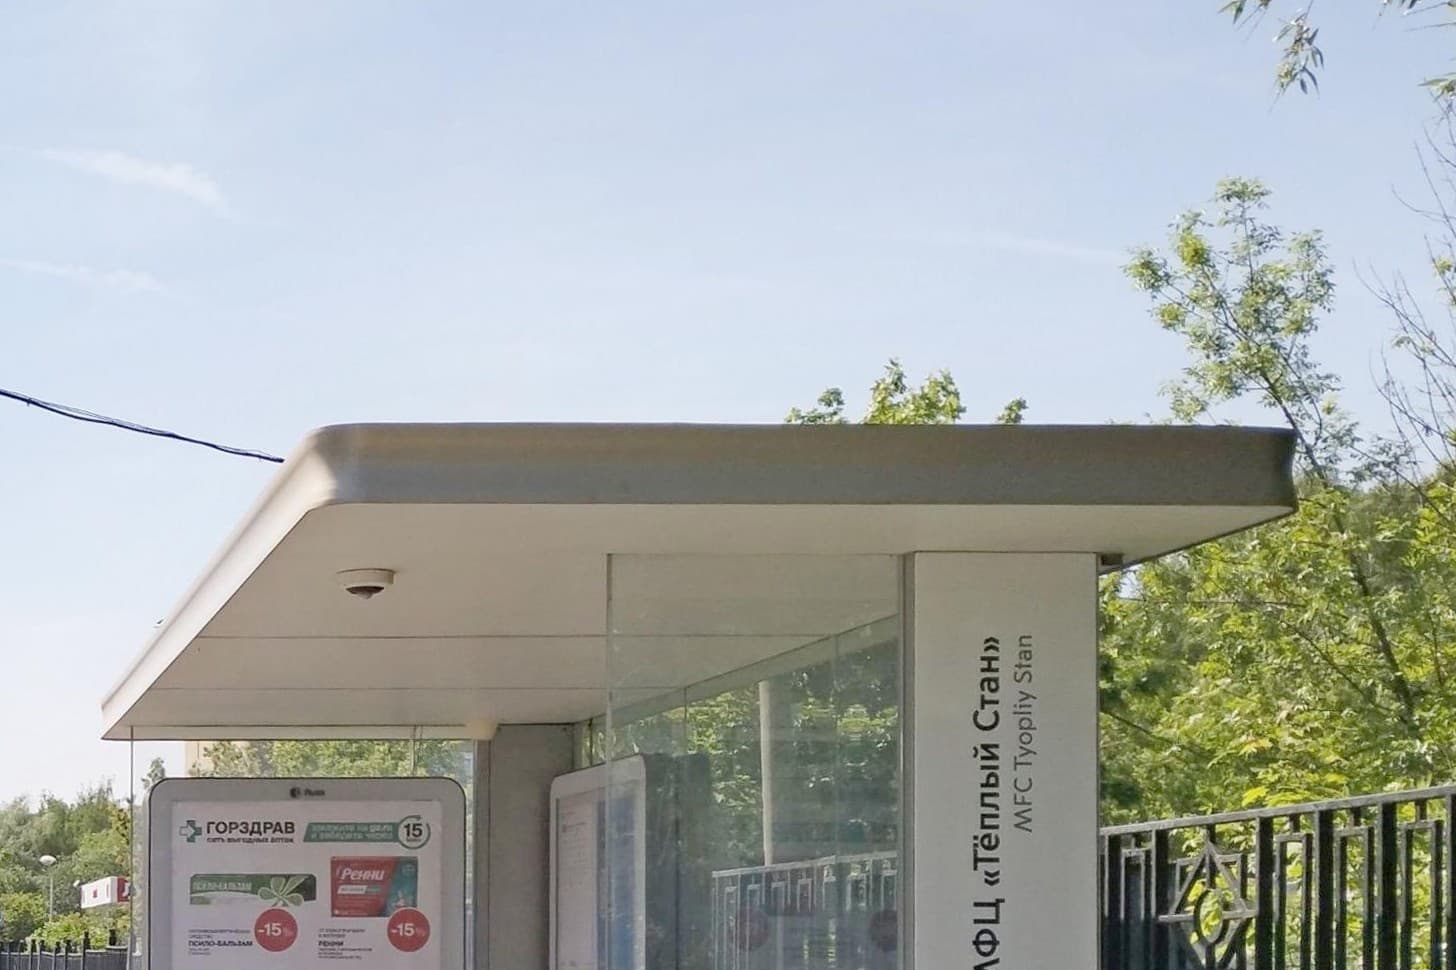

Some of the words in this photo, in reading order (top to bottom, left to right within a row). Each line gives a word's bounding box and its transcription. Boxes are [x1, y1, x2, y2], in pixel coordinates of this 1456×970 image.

[972, 636, 1000, 732] Стан»
[1012, 634, 1033, 683] Stan
[1012, 690, 1038, 772] Tyopliy
[206, 821, 295, 836] ГОРЗДРАВ
[404, 823, 423, 838] 15
[972, 743, 1000, 886] «Тёплый
[1012, 777, 1033, 833] MFC
[341, 868, 385, 881] Ренни
